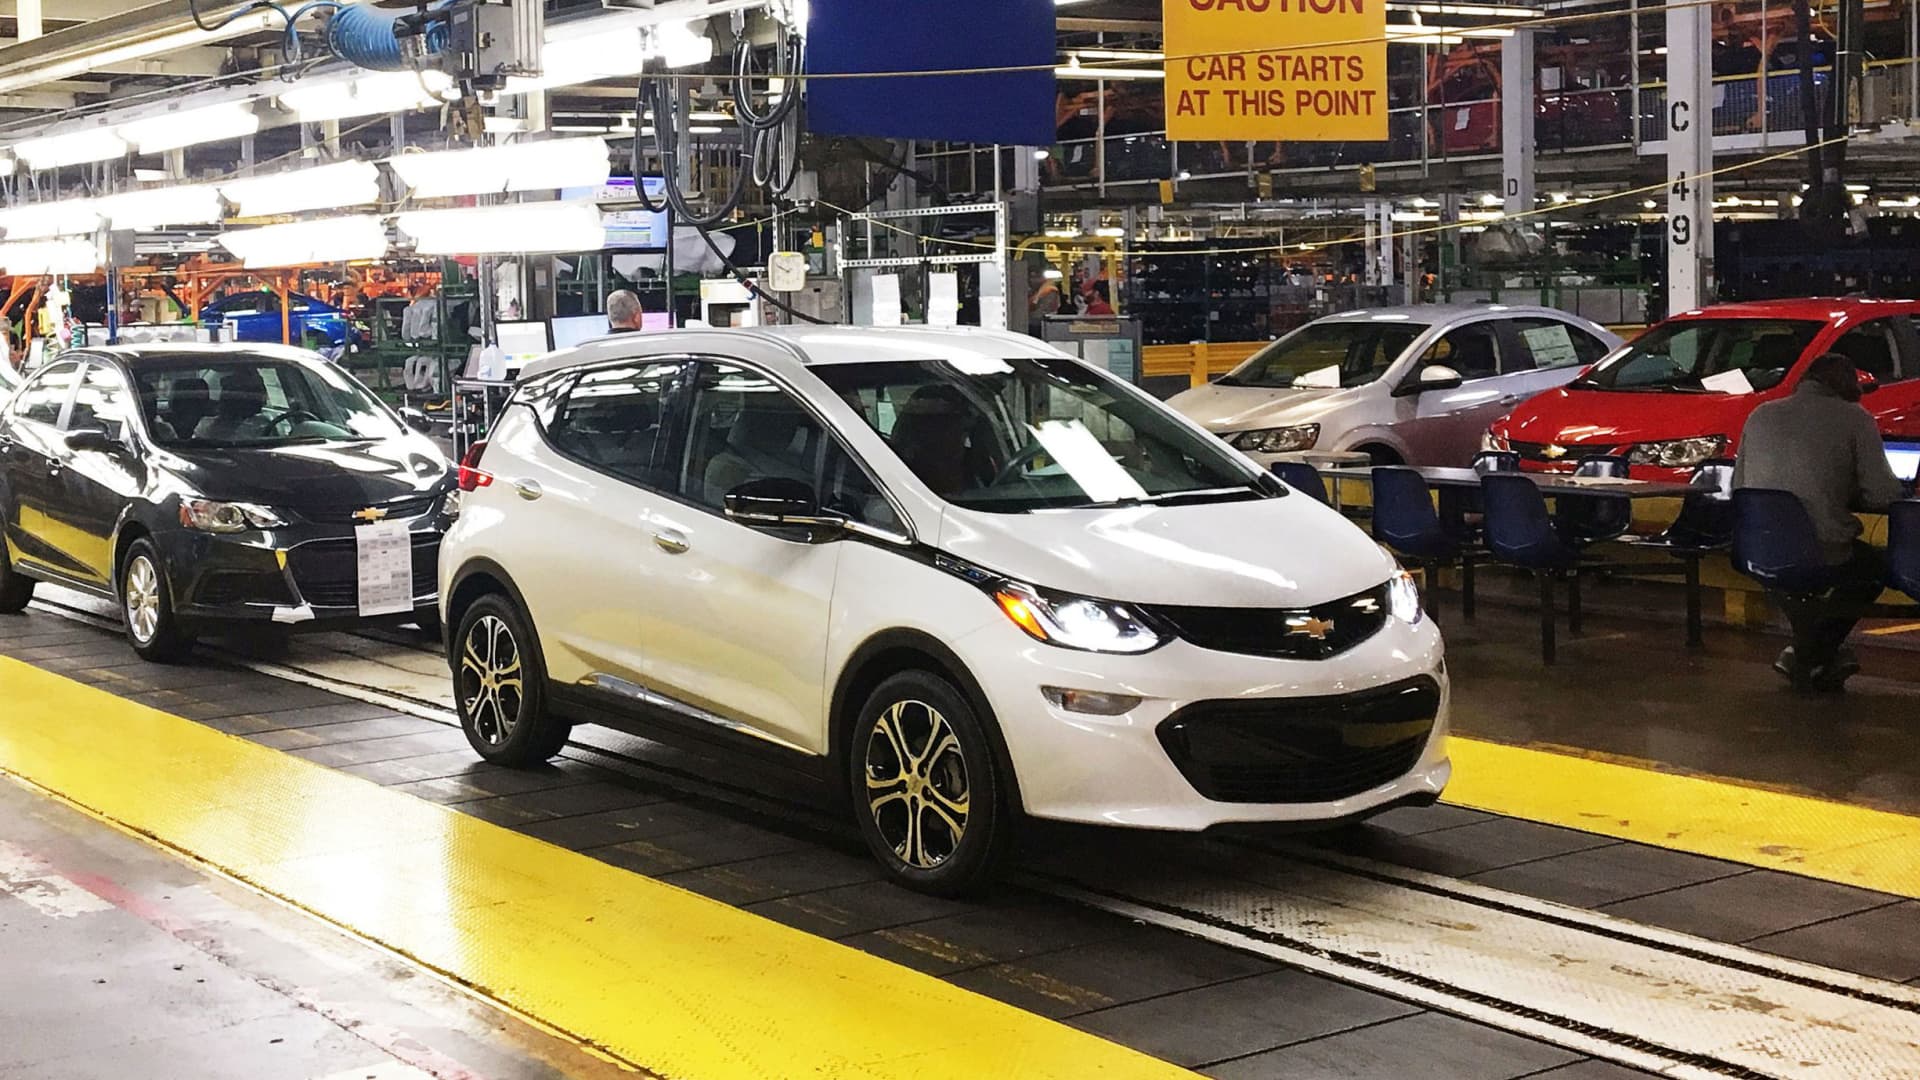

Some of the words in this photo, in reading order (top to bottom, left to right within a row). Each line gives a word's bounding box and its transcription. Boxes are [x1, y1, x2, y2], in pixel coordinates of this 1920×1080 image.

[1187, 55, 1246, 81] CAR
[1257, 55, 1364, 82] STARTS
[1176, 90, 1210, 116] AT
[1223, 90, 1285, 116] THIS
[1296, 90, 1376, 116] POINT
[1671, 101, 1689, 132] C
[1507, 178, 1518, 196] D
